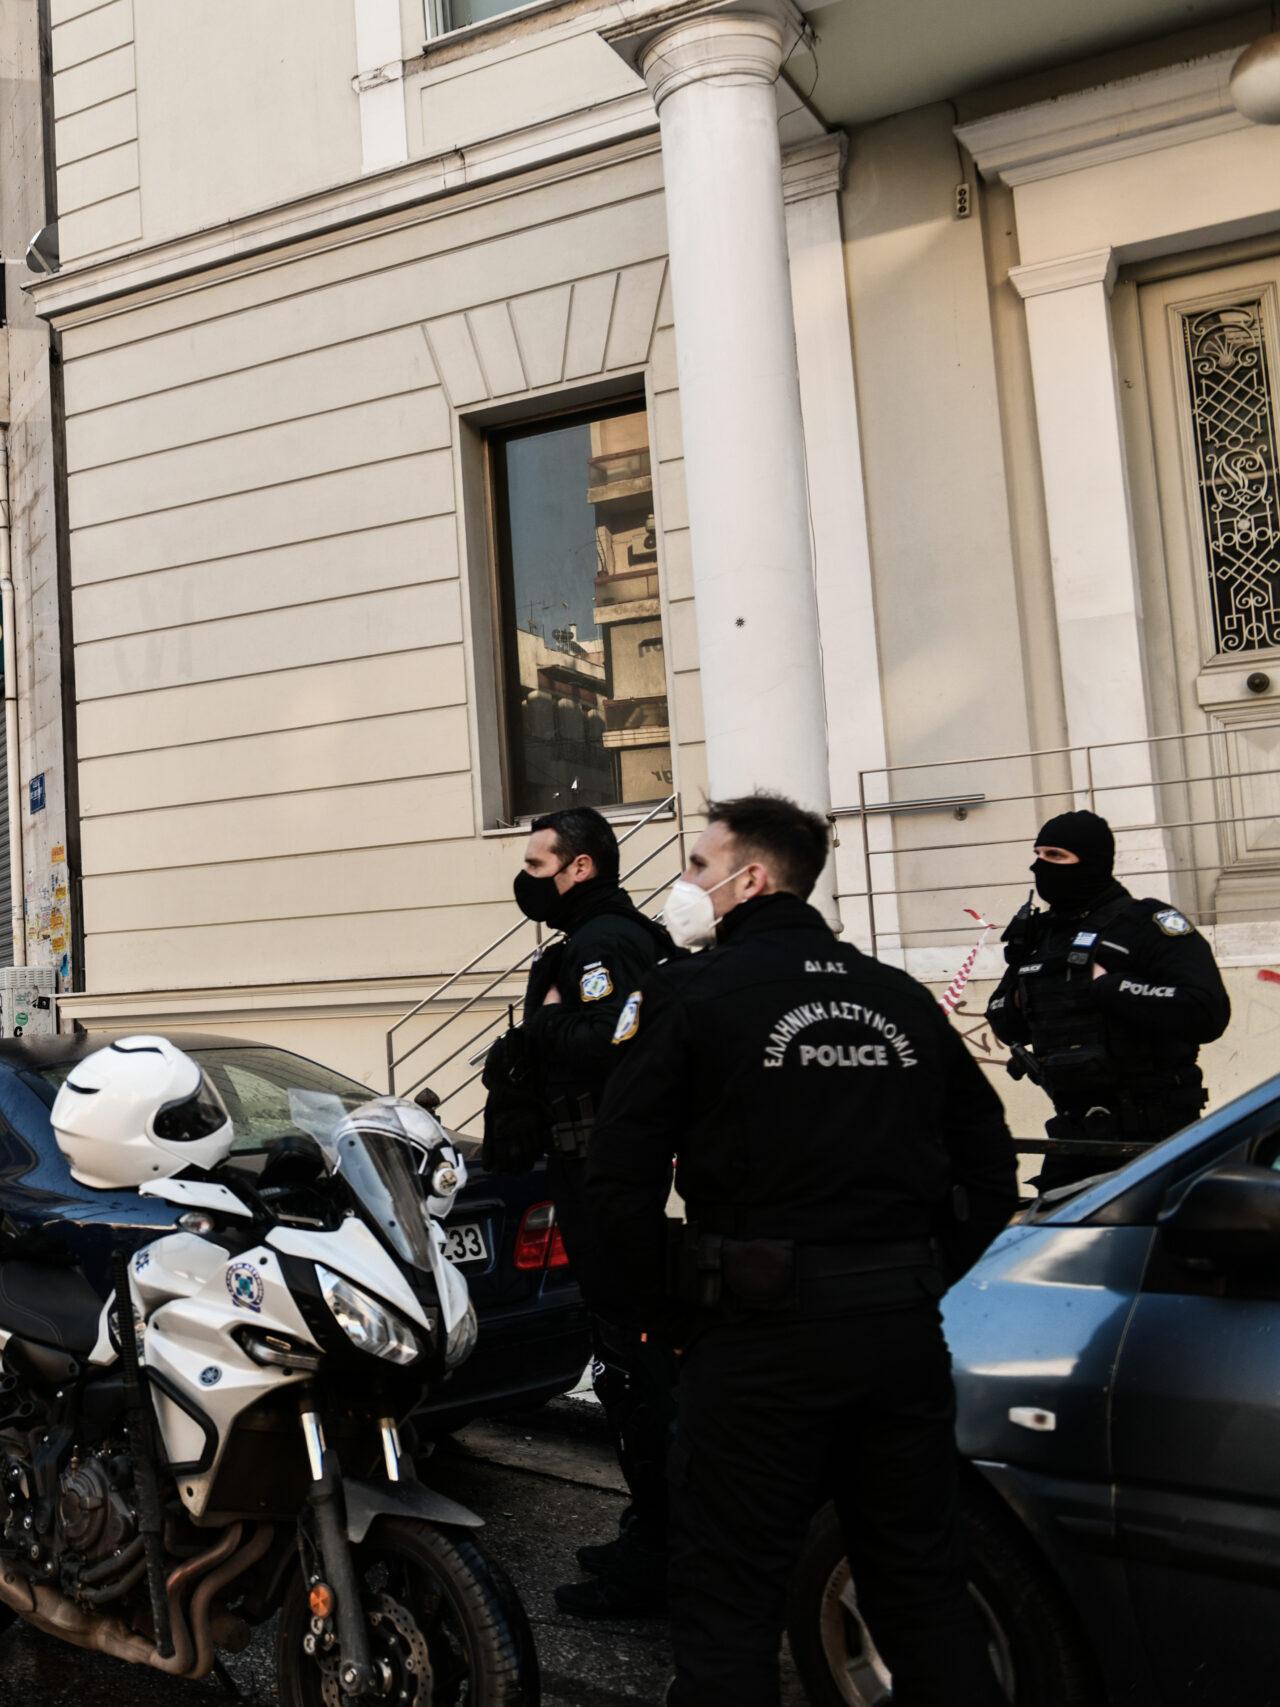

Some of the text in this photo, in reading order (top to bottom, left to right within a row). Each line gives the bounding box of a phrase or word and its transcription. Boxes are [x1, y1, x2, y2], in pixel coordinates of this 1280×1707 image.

[1119, 980, 1176, 997] POLICE
[763, 1002, 829, 1068] ΕΛΛΗΝΙΚΗ
[830, 1001, 918, 1068] ΑΣΤΥΝΟΜΙΑ
[799, 1045, 888, 1066] POLICE
